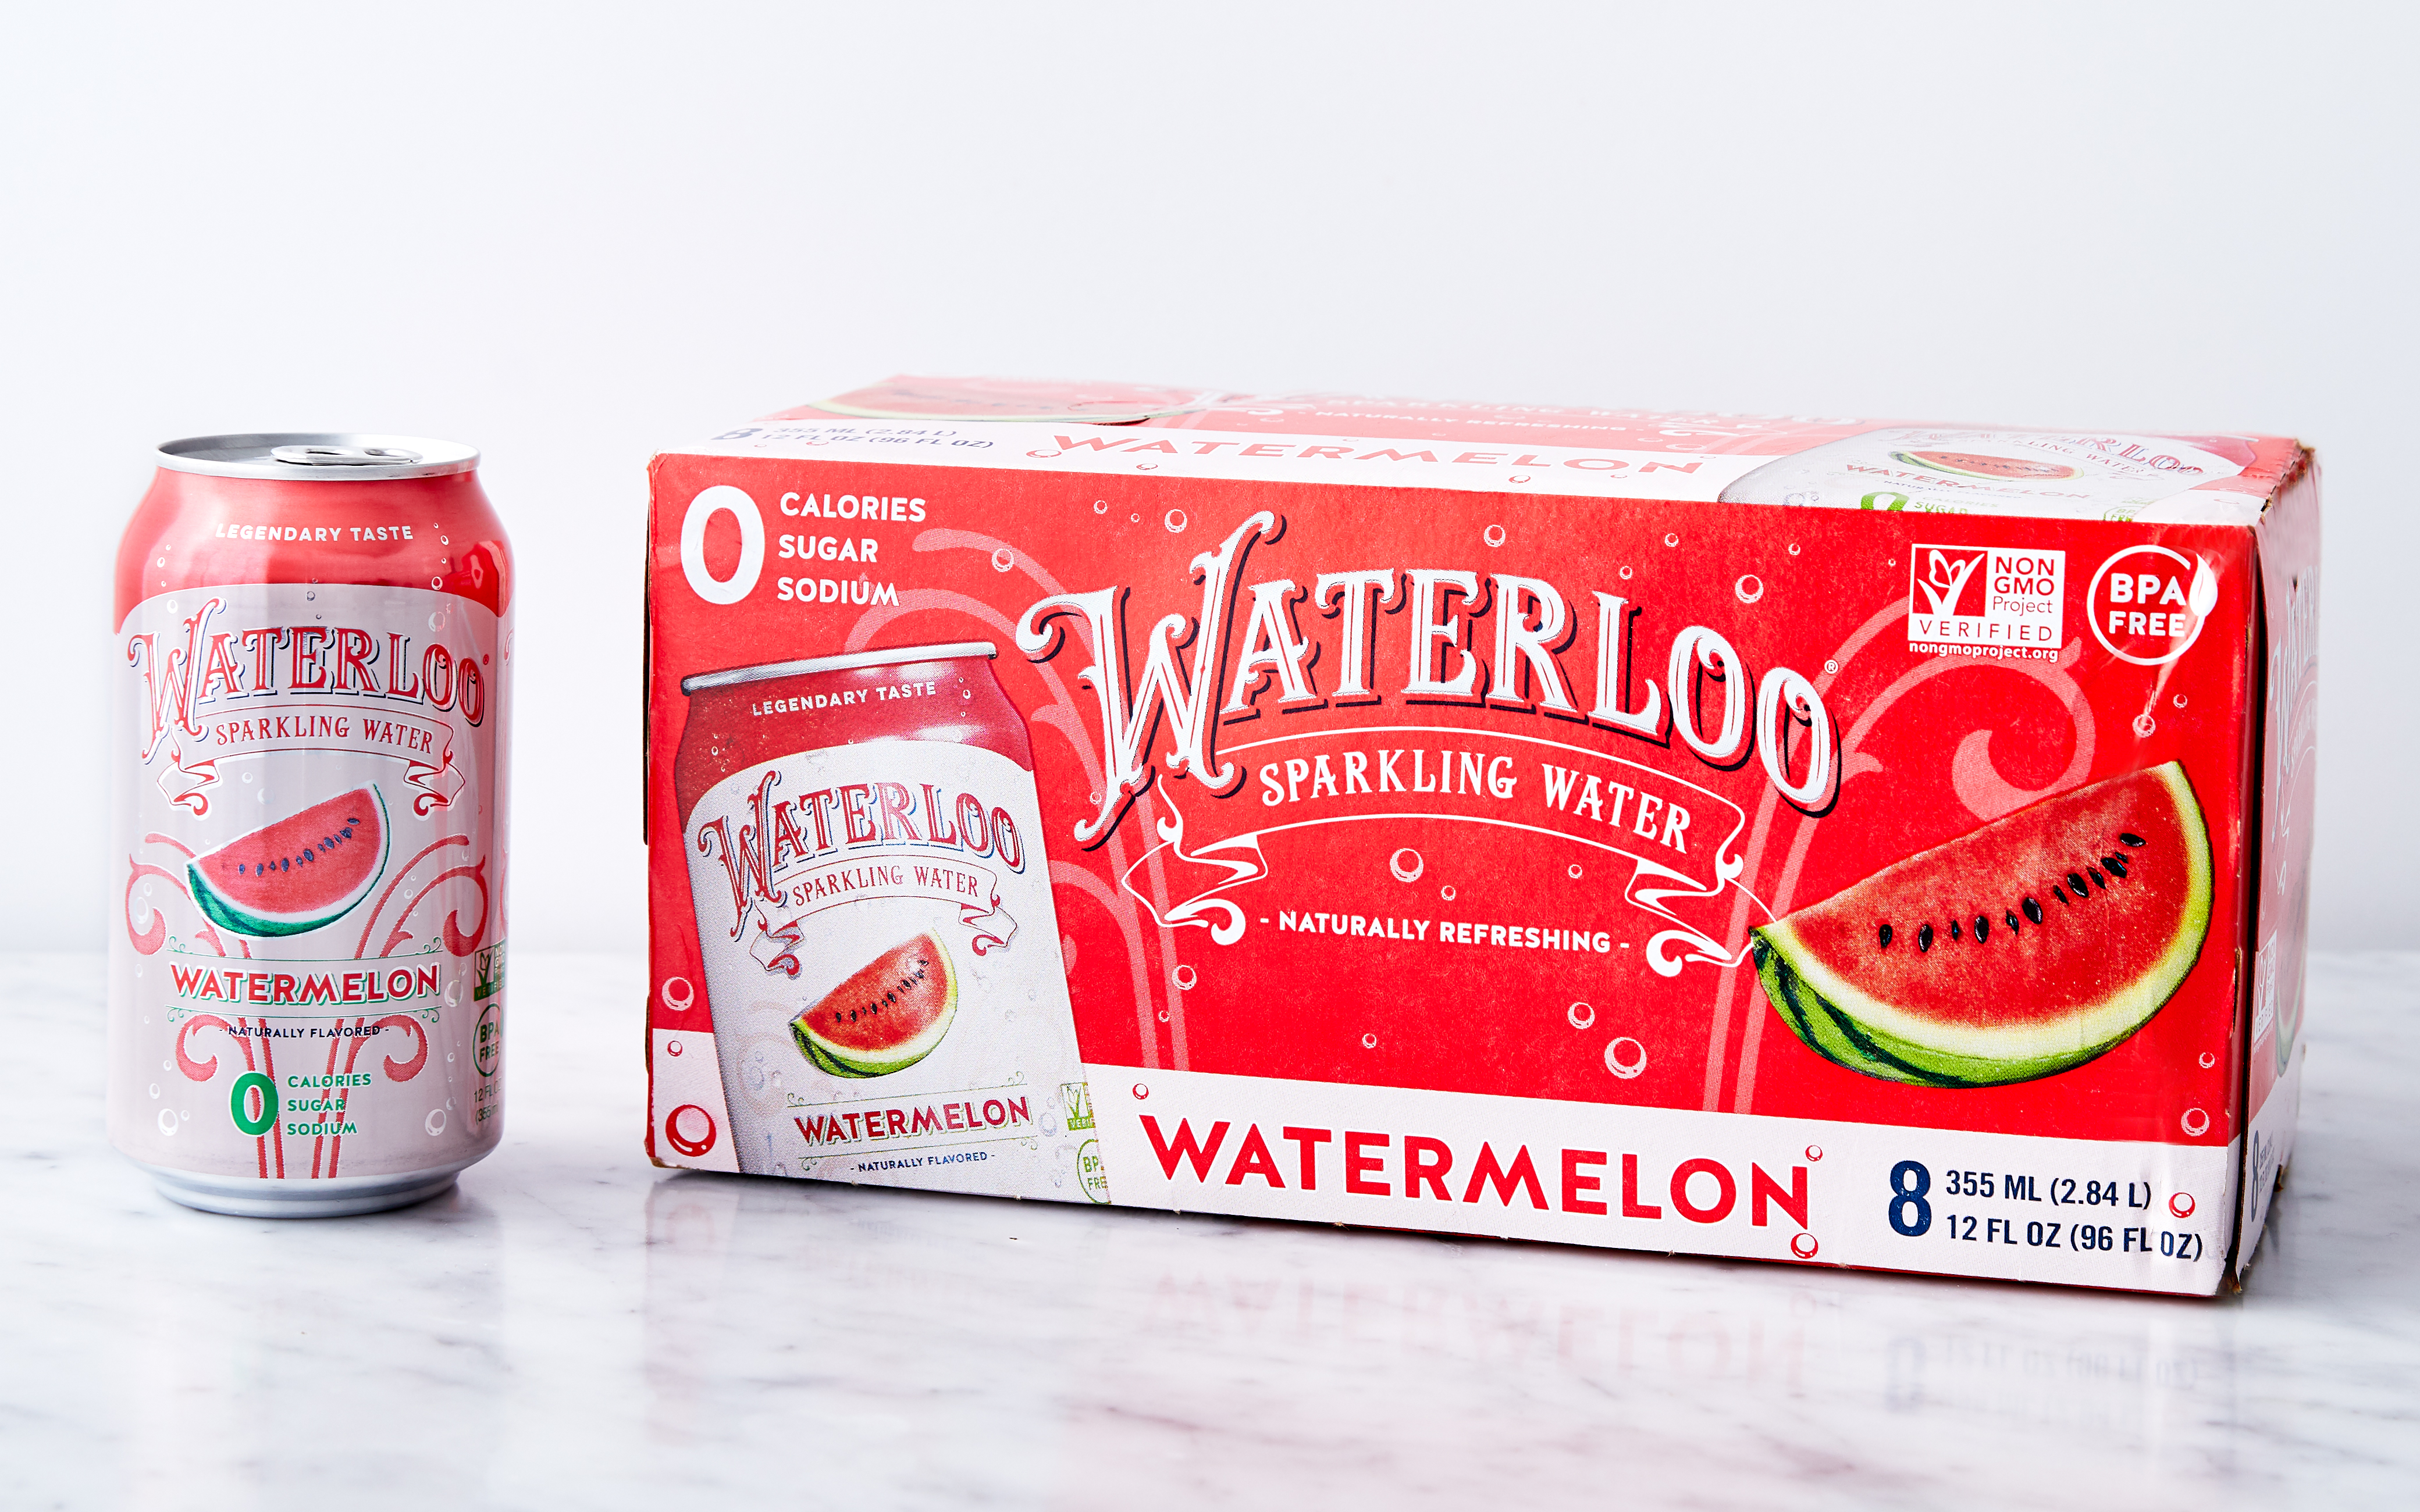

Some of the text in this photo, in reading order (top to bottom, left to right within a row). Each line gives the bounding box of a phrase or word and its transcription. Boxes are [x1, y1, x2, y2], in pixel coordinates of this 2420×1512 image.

[1054, 436, 1703, 474] WATERMELON
[780, 491, 926, 523] CALORIES
[216, 523, 414, 542] LEGENDARY TASTE
[681, 485, 765, 605] 0
[778, 534, 878, 563] SUGAR
[1995, 555, 2055, 576] NON
[777, 576, 900, 607] SODIUM
[1994, 576, 2055, 597] GMO
[2111, 572, 2187, 606] BPA
[1992, 595, 2054, 617] Project
[1919, 619, 2053, 642] VERIFIED
[2109, 610, 2186, 637] FREE
[1909, 642, 2059, 663] nongmoproject.org
[127, 597, 487, 764] WATERLOO
[1017, 509, 1840, 847] WATERLOO
[752, 681, 937, 716] LEGENDARY TASTE
[216, 715, 433, 755] SPARKLING WATER
[1260, 749, 1693, 854] SPARKLING WATER
[698, 771, 1025, 942] WATERLOO
[792, 865, 979, 907] SPARKLING WATER
[1279, 909, 1611, 954] NATURALLY REFRESHING
[170, 962, 440, 1005] WATERMELON
[229, 1025, 380, 1038] NATURALLY FLAVORED
[480, 1020, 499, 1044] BPA
[480, 1041, 499, 1062] FREE
[287, 1074, 372, 1088] CALORIES
[474, 1088, 483, 1103] 12
[230, 1072, 279, 1136] 0
[287, 1098, 346, 1112] SUGAR
[795, 1096, 1033, 1146] WATERMELON
[287, 1122, 358, 1136] SODIUM
[858, 1151, 987, 1172] NATURALLY FLAVORED
[1139, 1114, 1808, 1231] WATERMELON
[2251, 1130, 2259, 1222] 8
[1888, 1160, 1932, 1237] 8
[1946, 1169, 2152, 1210] 355 ML (2.84 L)
[1948, 1215, 2204, 1263] 12 FL OZ (96 FL OZ)
